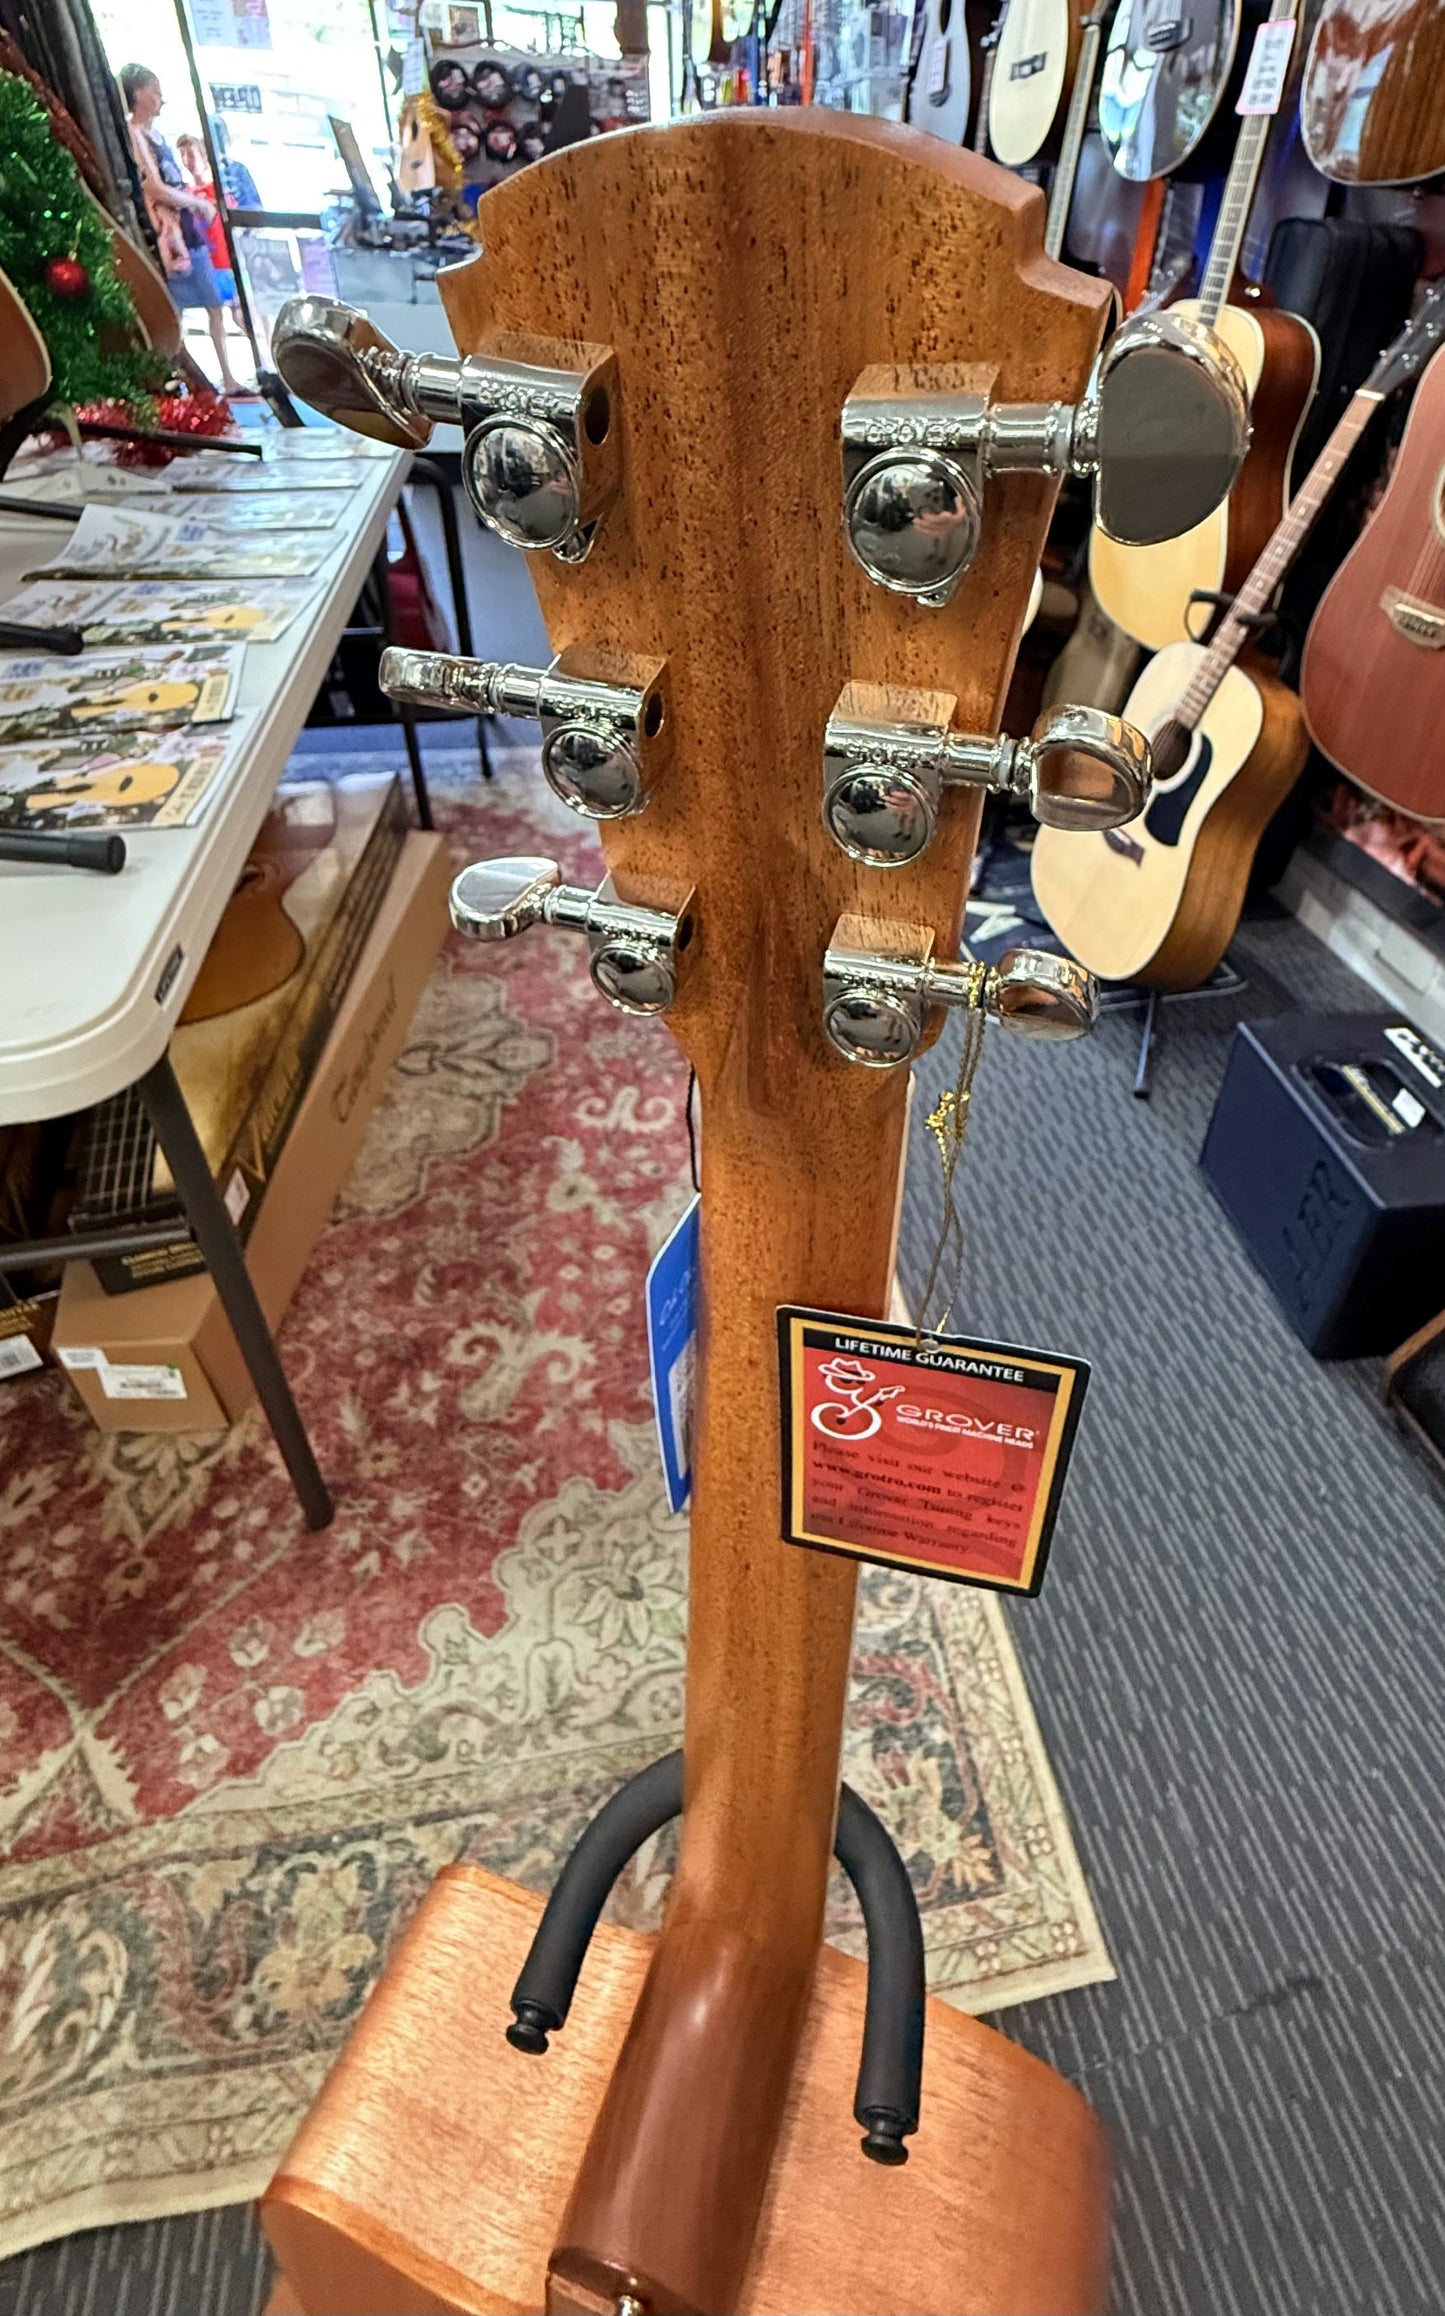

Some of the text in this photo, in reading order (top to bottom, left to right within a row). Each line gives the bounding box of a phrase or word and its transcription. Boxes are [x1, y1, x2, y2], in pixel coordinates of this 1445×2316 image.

[835, 1337, 1025, 1382] LIFETIME GUARANTEE
[896, 1404, 1035, 1441] GROVER
[813, 1441, 859, 1458] Please
[868, 1455, 899, 1467] visit
[908, 1463, 933, 1474] our
[942, 1470, 1001, 1489] website
[813, 1461, 1023, 1512] www.grotro.com to register
[811, 1478, 1021, 1530] your Grover Tuning keys
[811, 1496, 1018, 1548] and information regarding
[839, 1517, 898, 1537] Lifetime
[903, 1530, 969, 1554] Warranty
